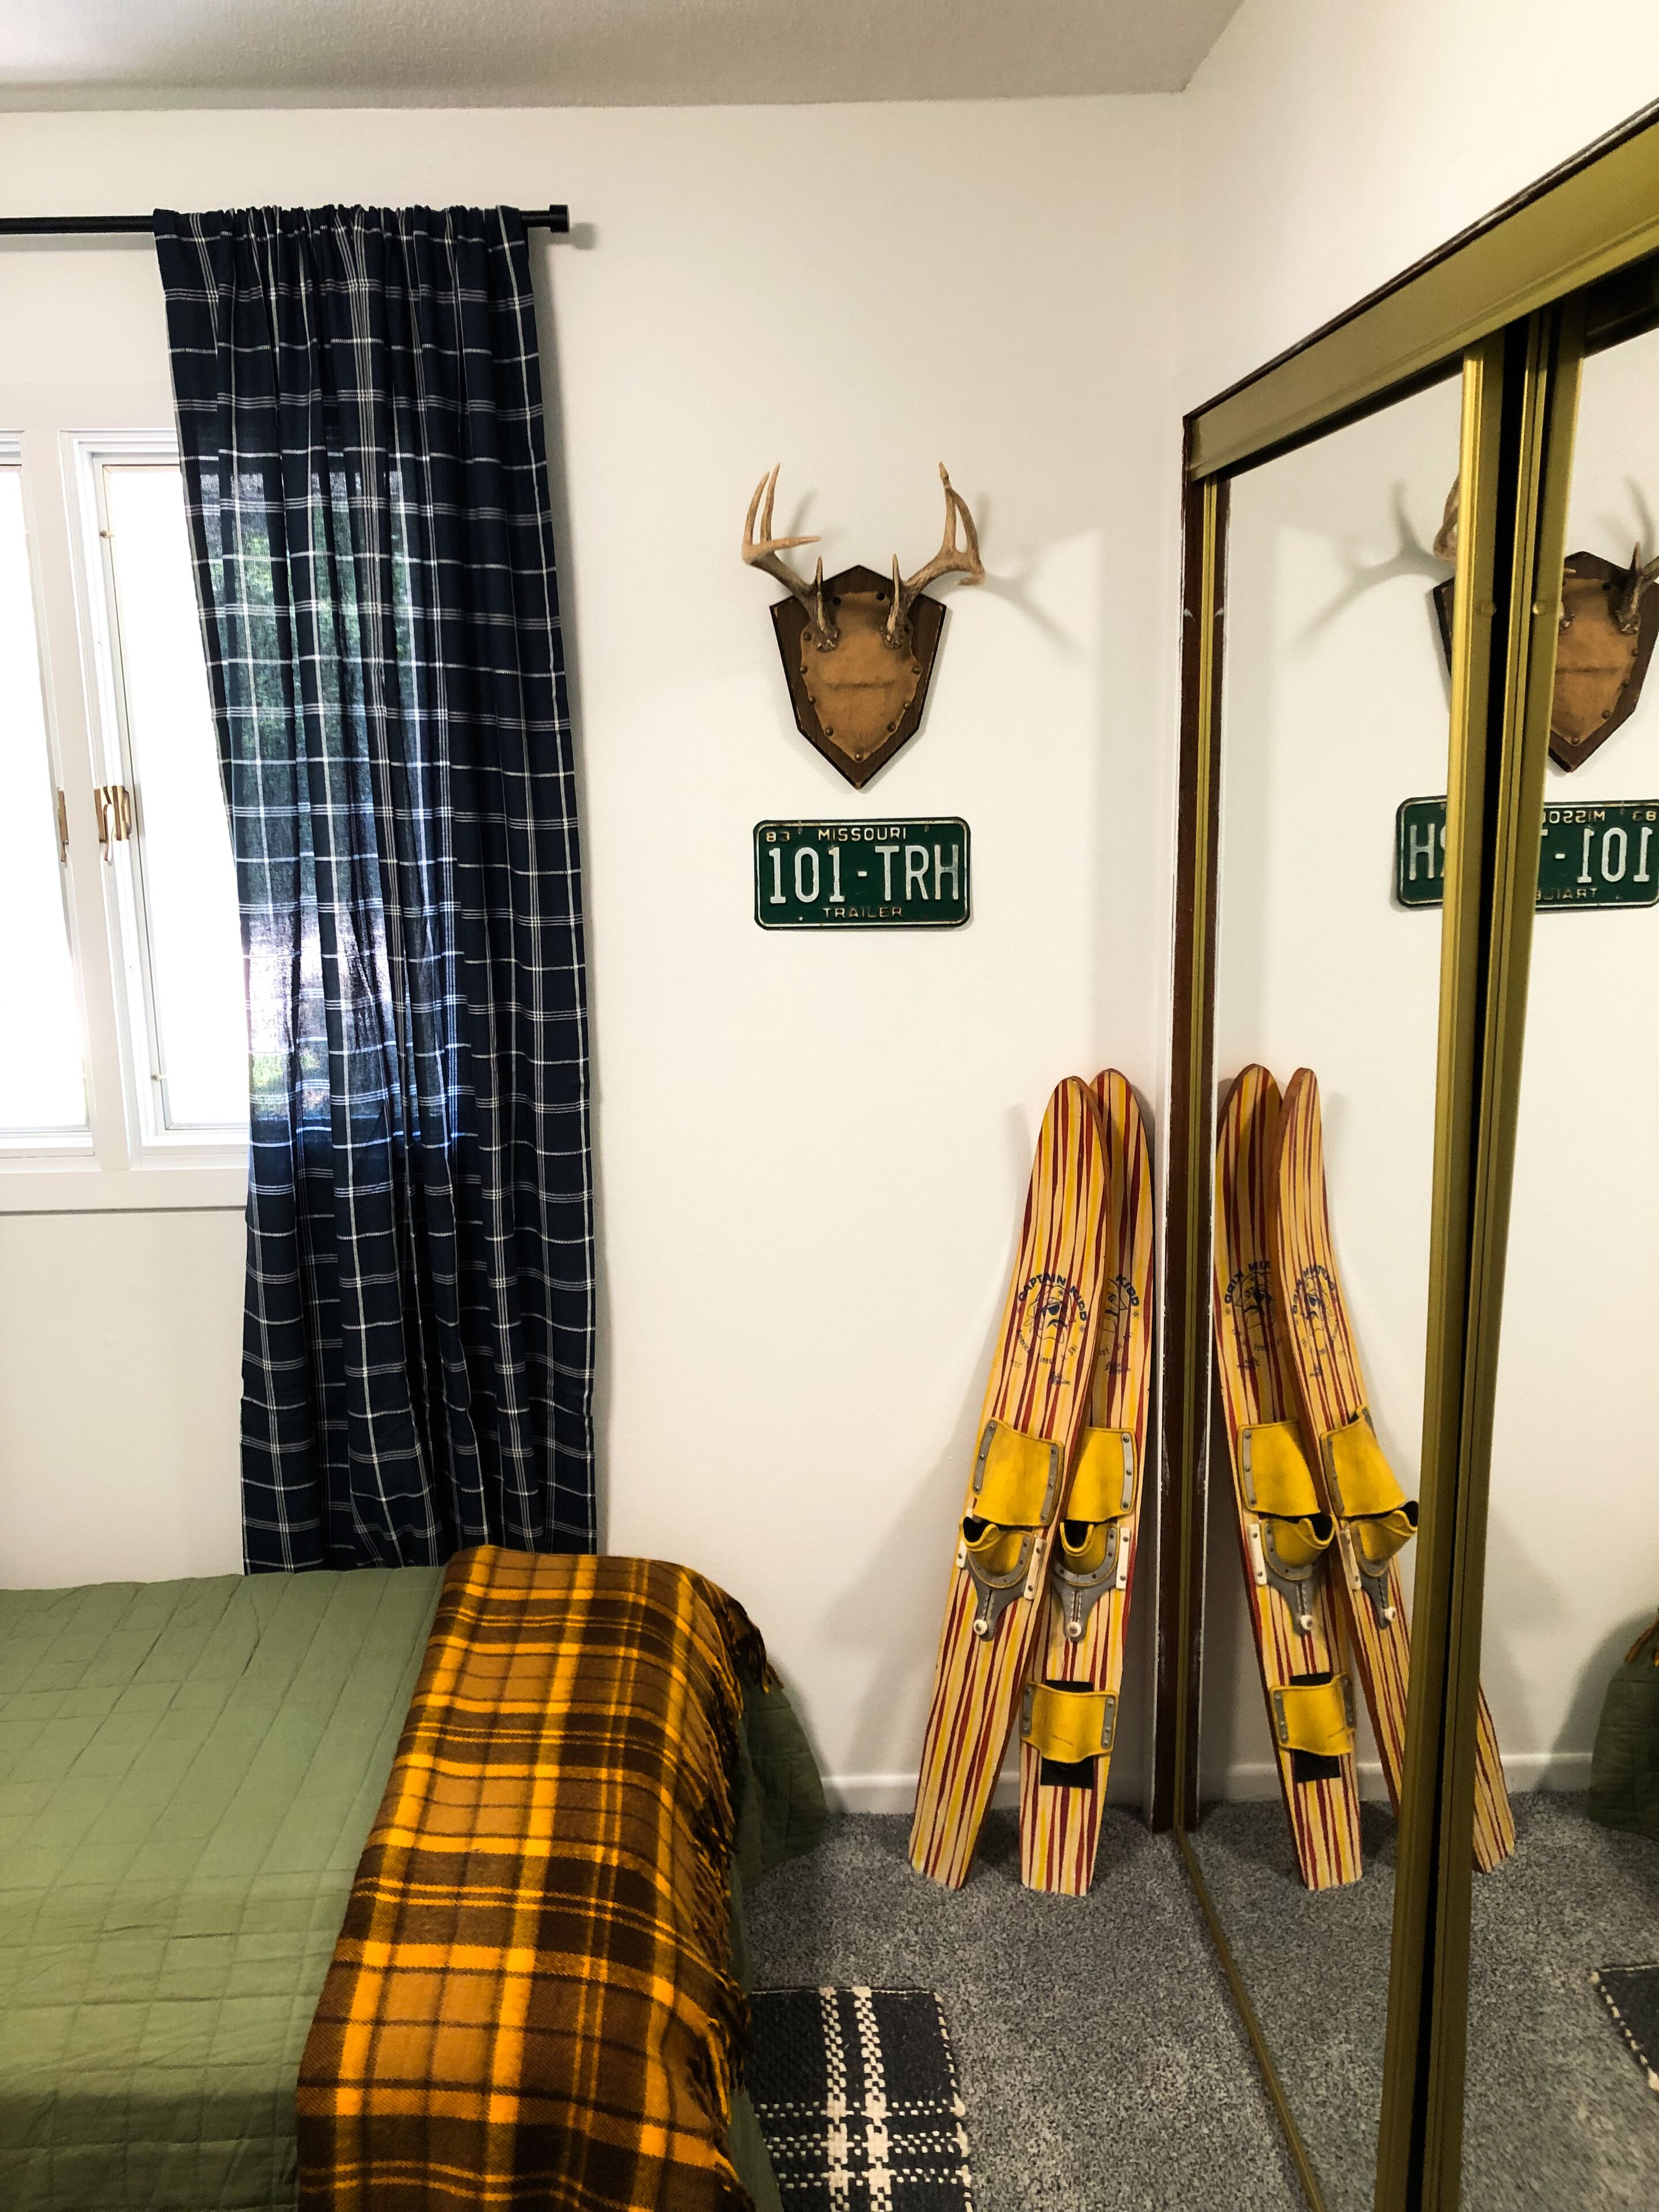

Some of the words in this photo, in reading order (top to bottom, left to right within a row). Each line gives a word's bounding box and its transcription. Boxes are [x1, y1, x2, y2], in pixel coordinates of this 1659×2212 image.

[766, 831, 791, 843] 83
[818, 827, 907, 842] MISSOURI
[822, 906, 903, 919] TRAILER
[1018, 1272, 1067, 1301] CAPTAIN
[1070, 1285, 1087, 1321] KIDD
[1115, 1273, 1140, 1307] KIDD
